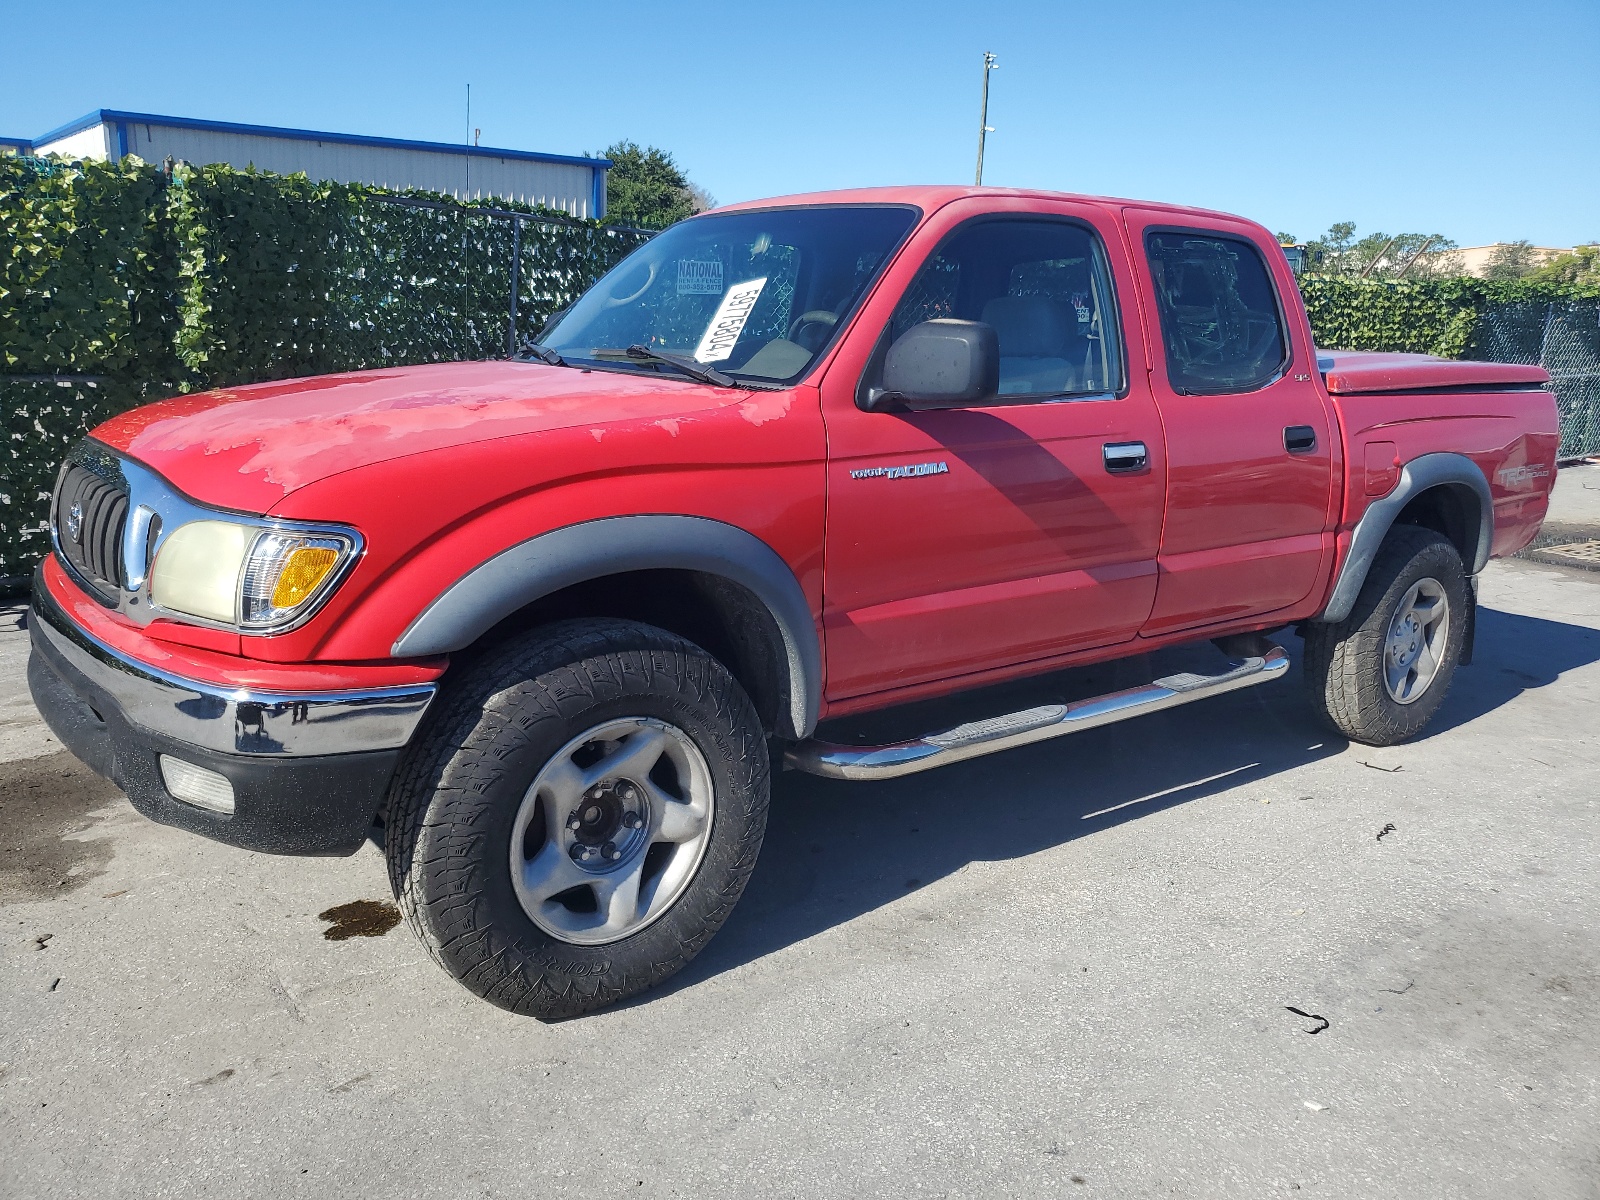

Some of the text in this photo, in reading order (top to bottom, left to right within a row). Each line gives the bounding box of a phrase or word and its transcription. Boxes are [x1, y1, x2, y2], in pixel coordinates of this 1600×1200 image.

[679, 262, 722, 278] NATIONAL
[850, 461, 949, 479] TOYOTA TACOMA
[1498, 467, 1525, 487] TRD
